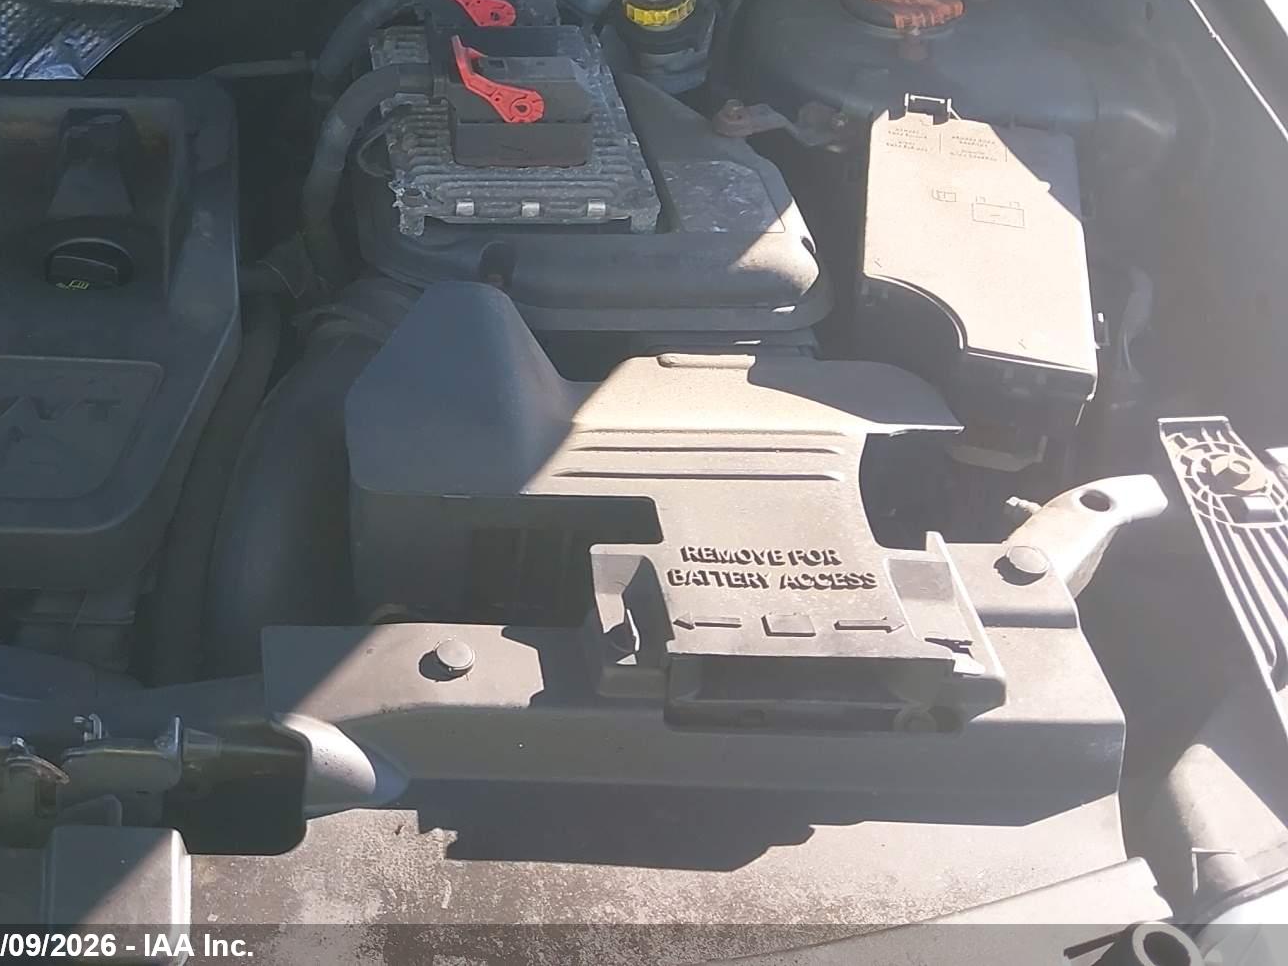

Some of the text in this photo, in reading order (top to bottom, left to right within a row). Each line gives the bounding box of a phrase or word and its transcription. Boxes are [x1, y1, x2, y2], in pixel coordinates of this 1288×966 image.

[680, 545, 842, 567] REMOVE FOR
[666, 568, 879, 592] BATTERY ACCESS
